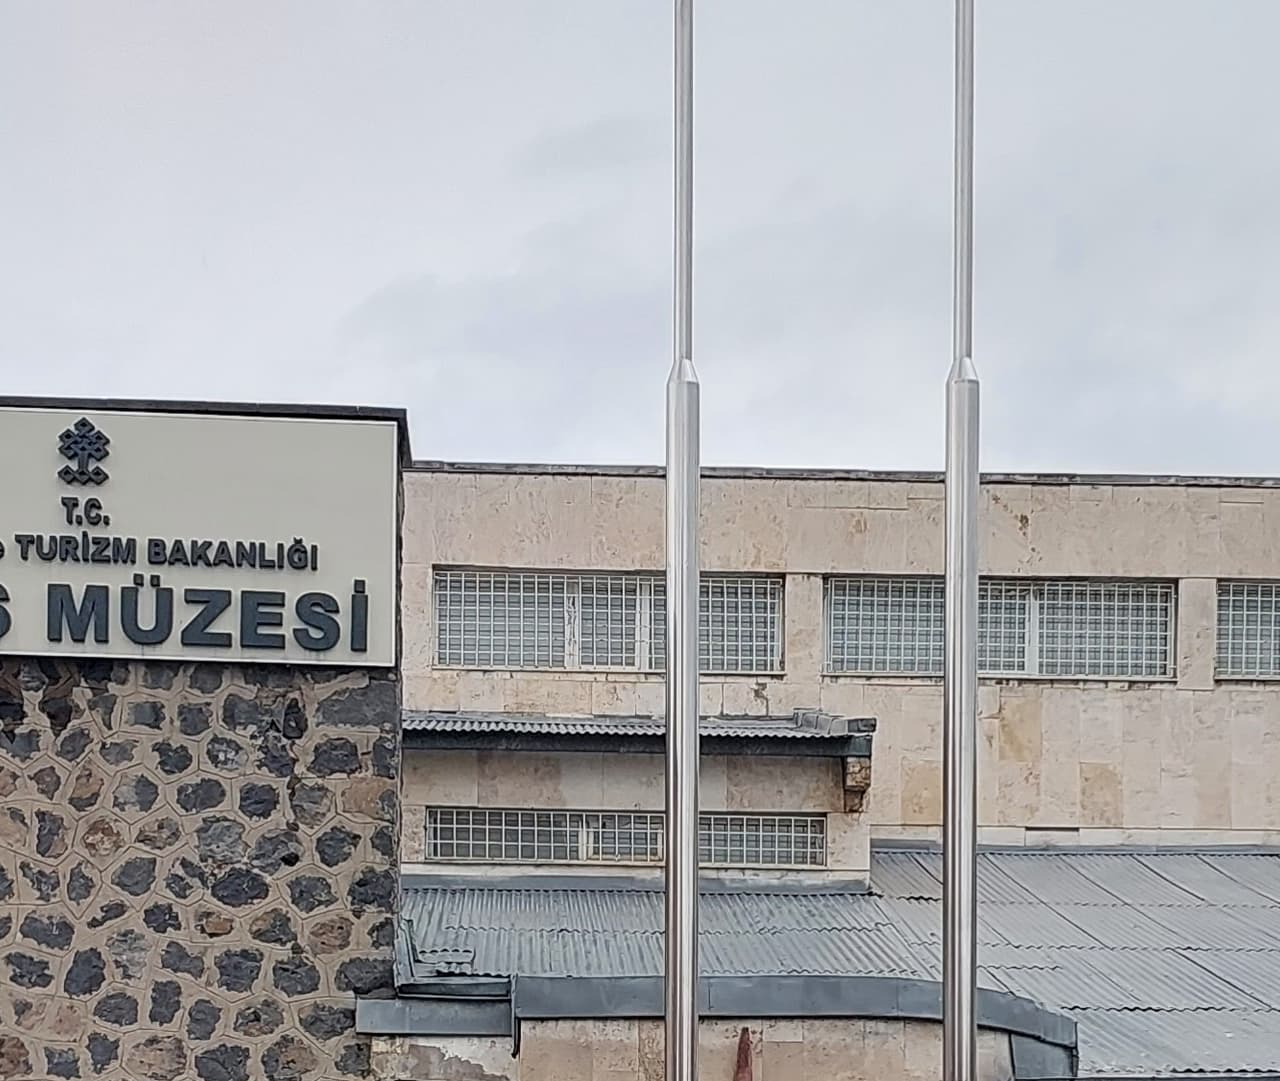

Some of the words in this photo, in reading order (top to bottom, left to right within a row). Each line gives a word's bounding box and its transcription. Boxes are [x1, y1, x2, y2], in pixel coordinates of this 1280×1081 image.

[61, 496, 111, 527] T.C.
[15, 531, 137, 566] TURİZM
[148, 538, 318, 572] BAKANLIĞI
[47, 573, 369, 654] MÜZESİ
